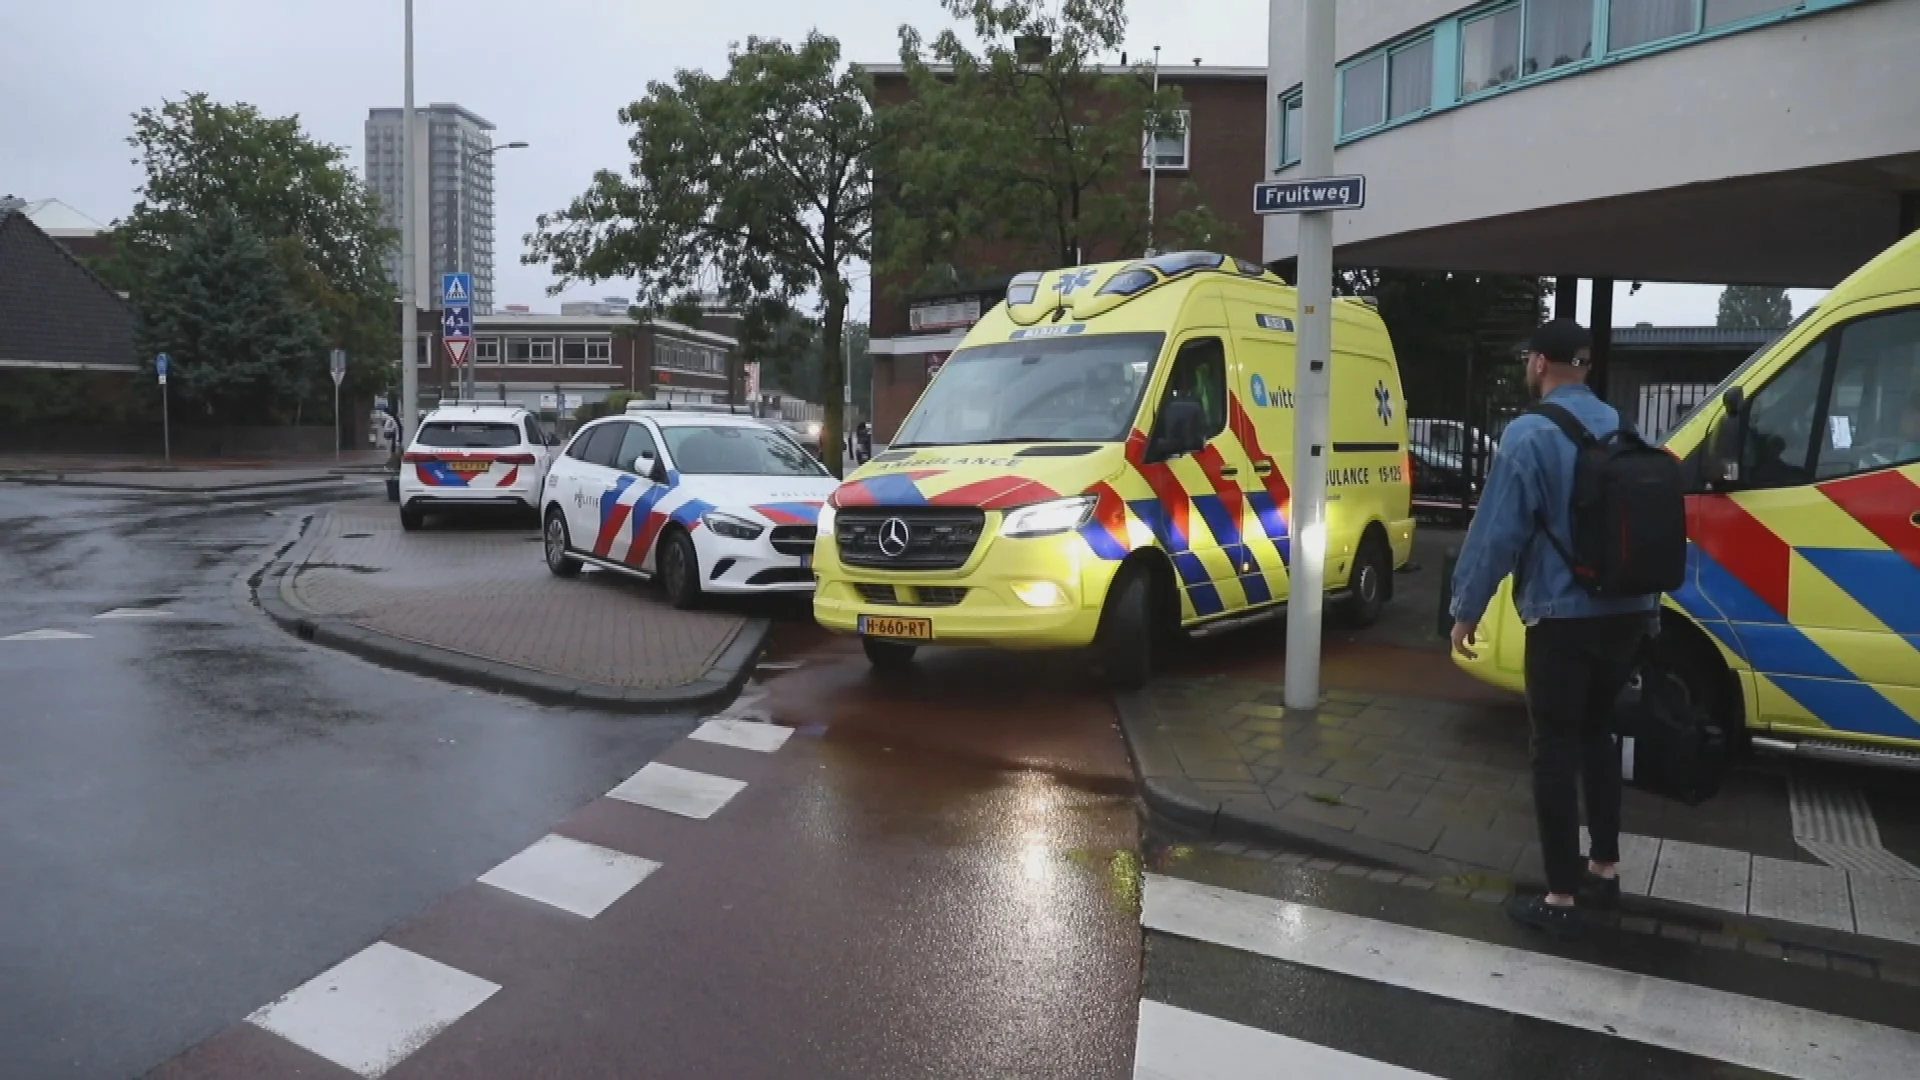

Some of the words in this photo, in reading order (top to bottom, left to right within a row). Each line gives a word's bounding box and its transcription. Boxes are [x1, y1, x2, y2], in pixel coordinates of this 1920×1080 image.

[1265, 185, 1350, 205] Fruitweg
[1268, 385, 1295, 409] witt
[866, 618, 926, 637] H-660-RT
